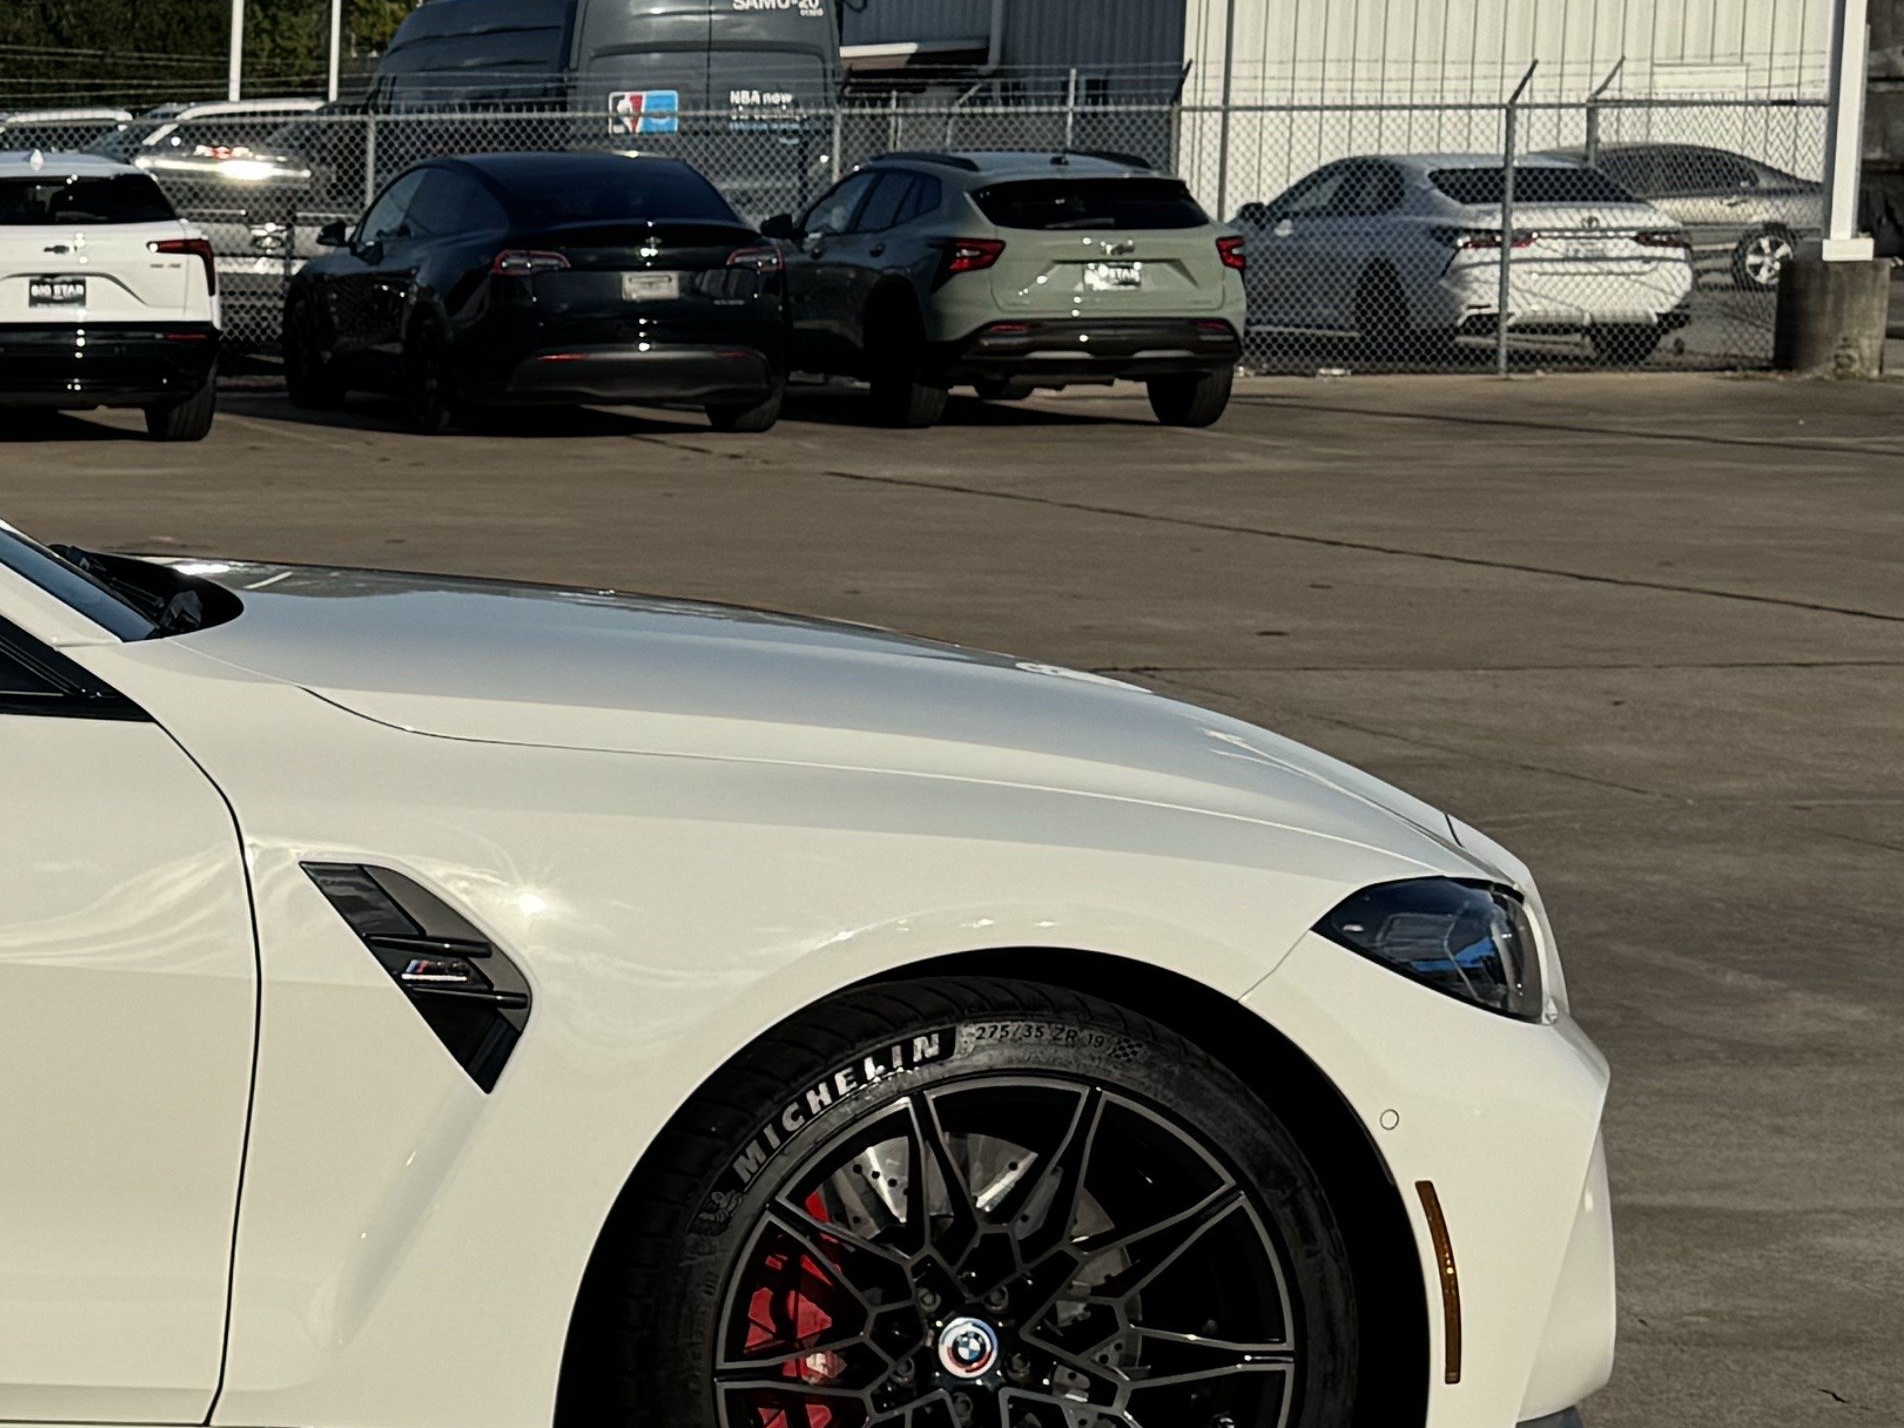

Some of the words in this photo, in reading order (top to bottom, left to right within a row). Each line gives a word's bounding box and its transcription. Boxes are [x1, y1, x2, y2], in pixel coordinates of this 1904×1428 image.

[730, 89, 761, 105] NBA
[762, 92, 792, 105] now
[975, 1024, 1045, 1041] 275/35
[1052, 1026, 1079, 1043] ZR
[1087, 1033, 1105, 1048] 19
[732, 1032, 940, 1184] MICHELIN
